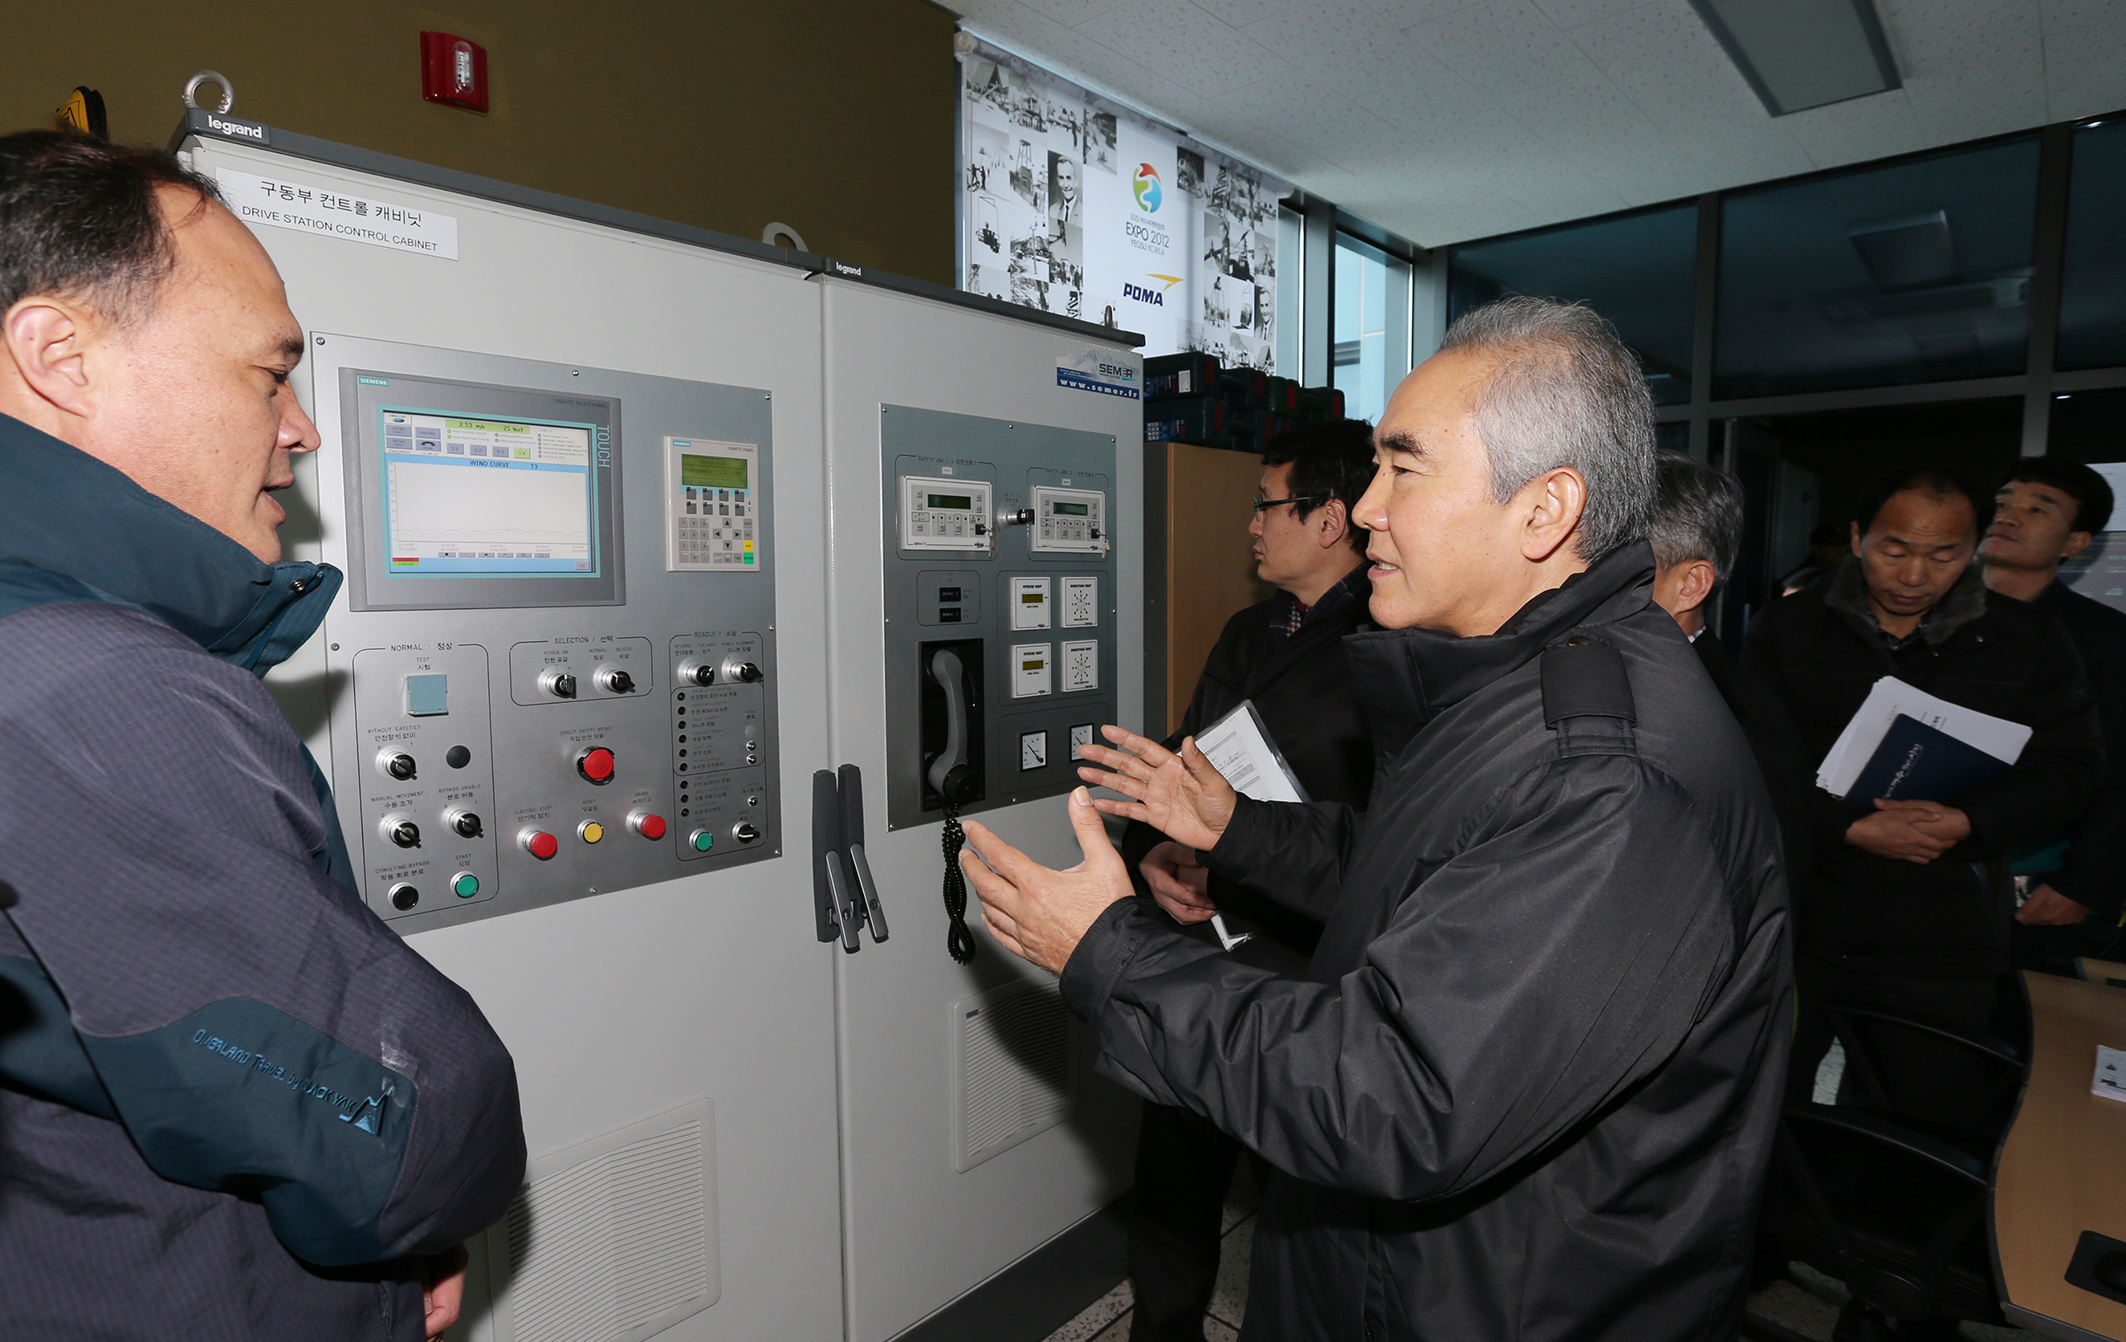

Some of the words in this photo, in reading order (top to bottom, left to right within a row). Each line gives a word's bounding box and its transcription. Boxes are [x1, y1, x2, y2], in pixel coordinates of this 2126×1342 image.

[208, 115, 262, 139] legrand
[260, 180, 313, 204] 구동부
[320, 192, 368, 216] 컨트롤
[375, 202, 422, 228] 캐비닛
[242, 205, 280, 222] DRIVE
[283, 213, 333, 232] STATION
[336, 223, 390, 242] CONTROL
[392, 234, 437, 251] CABINET
[1126, 221, 1149, 241] EXPO
[1151, 230, 1170, 248] 2012
[1130, 238, 1148, 251] YEOSU
[1148, 245, 1165, 256] KOREA
[836, 262, 861, 276] legrand
[1123, 282, 1164, 307] POMA
[1060, 379, 1137, 398] www.semer.fr
[597, 425, 610, 467] TOUCH
[470, 460, 487, 468] WIND
[489, 461, 510, 469] CURVE
[390, 644, 422, 652] NORMAL
[437, 642, 453, 651] 정상
[600, 635, 613, 643] 선택
[395, 724, 421, 732] SAFETIES
[396, 791, 424, 799] MOVEMENT
[514, 807, 537, 815] ELECTRIC
[375, 865, 406, 874] CONVEYING
[408, 860, 430, 868] BYPASS
[193, 1028, 250, 1064] OVERLAND
[287, 1073, 300, 1090] by
[302, 1078, 334, 1101] BLACK
[334, 1091, 356, 1112] YAK
